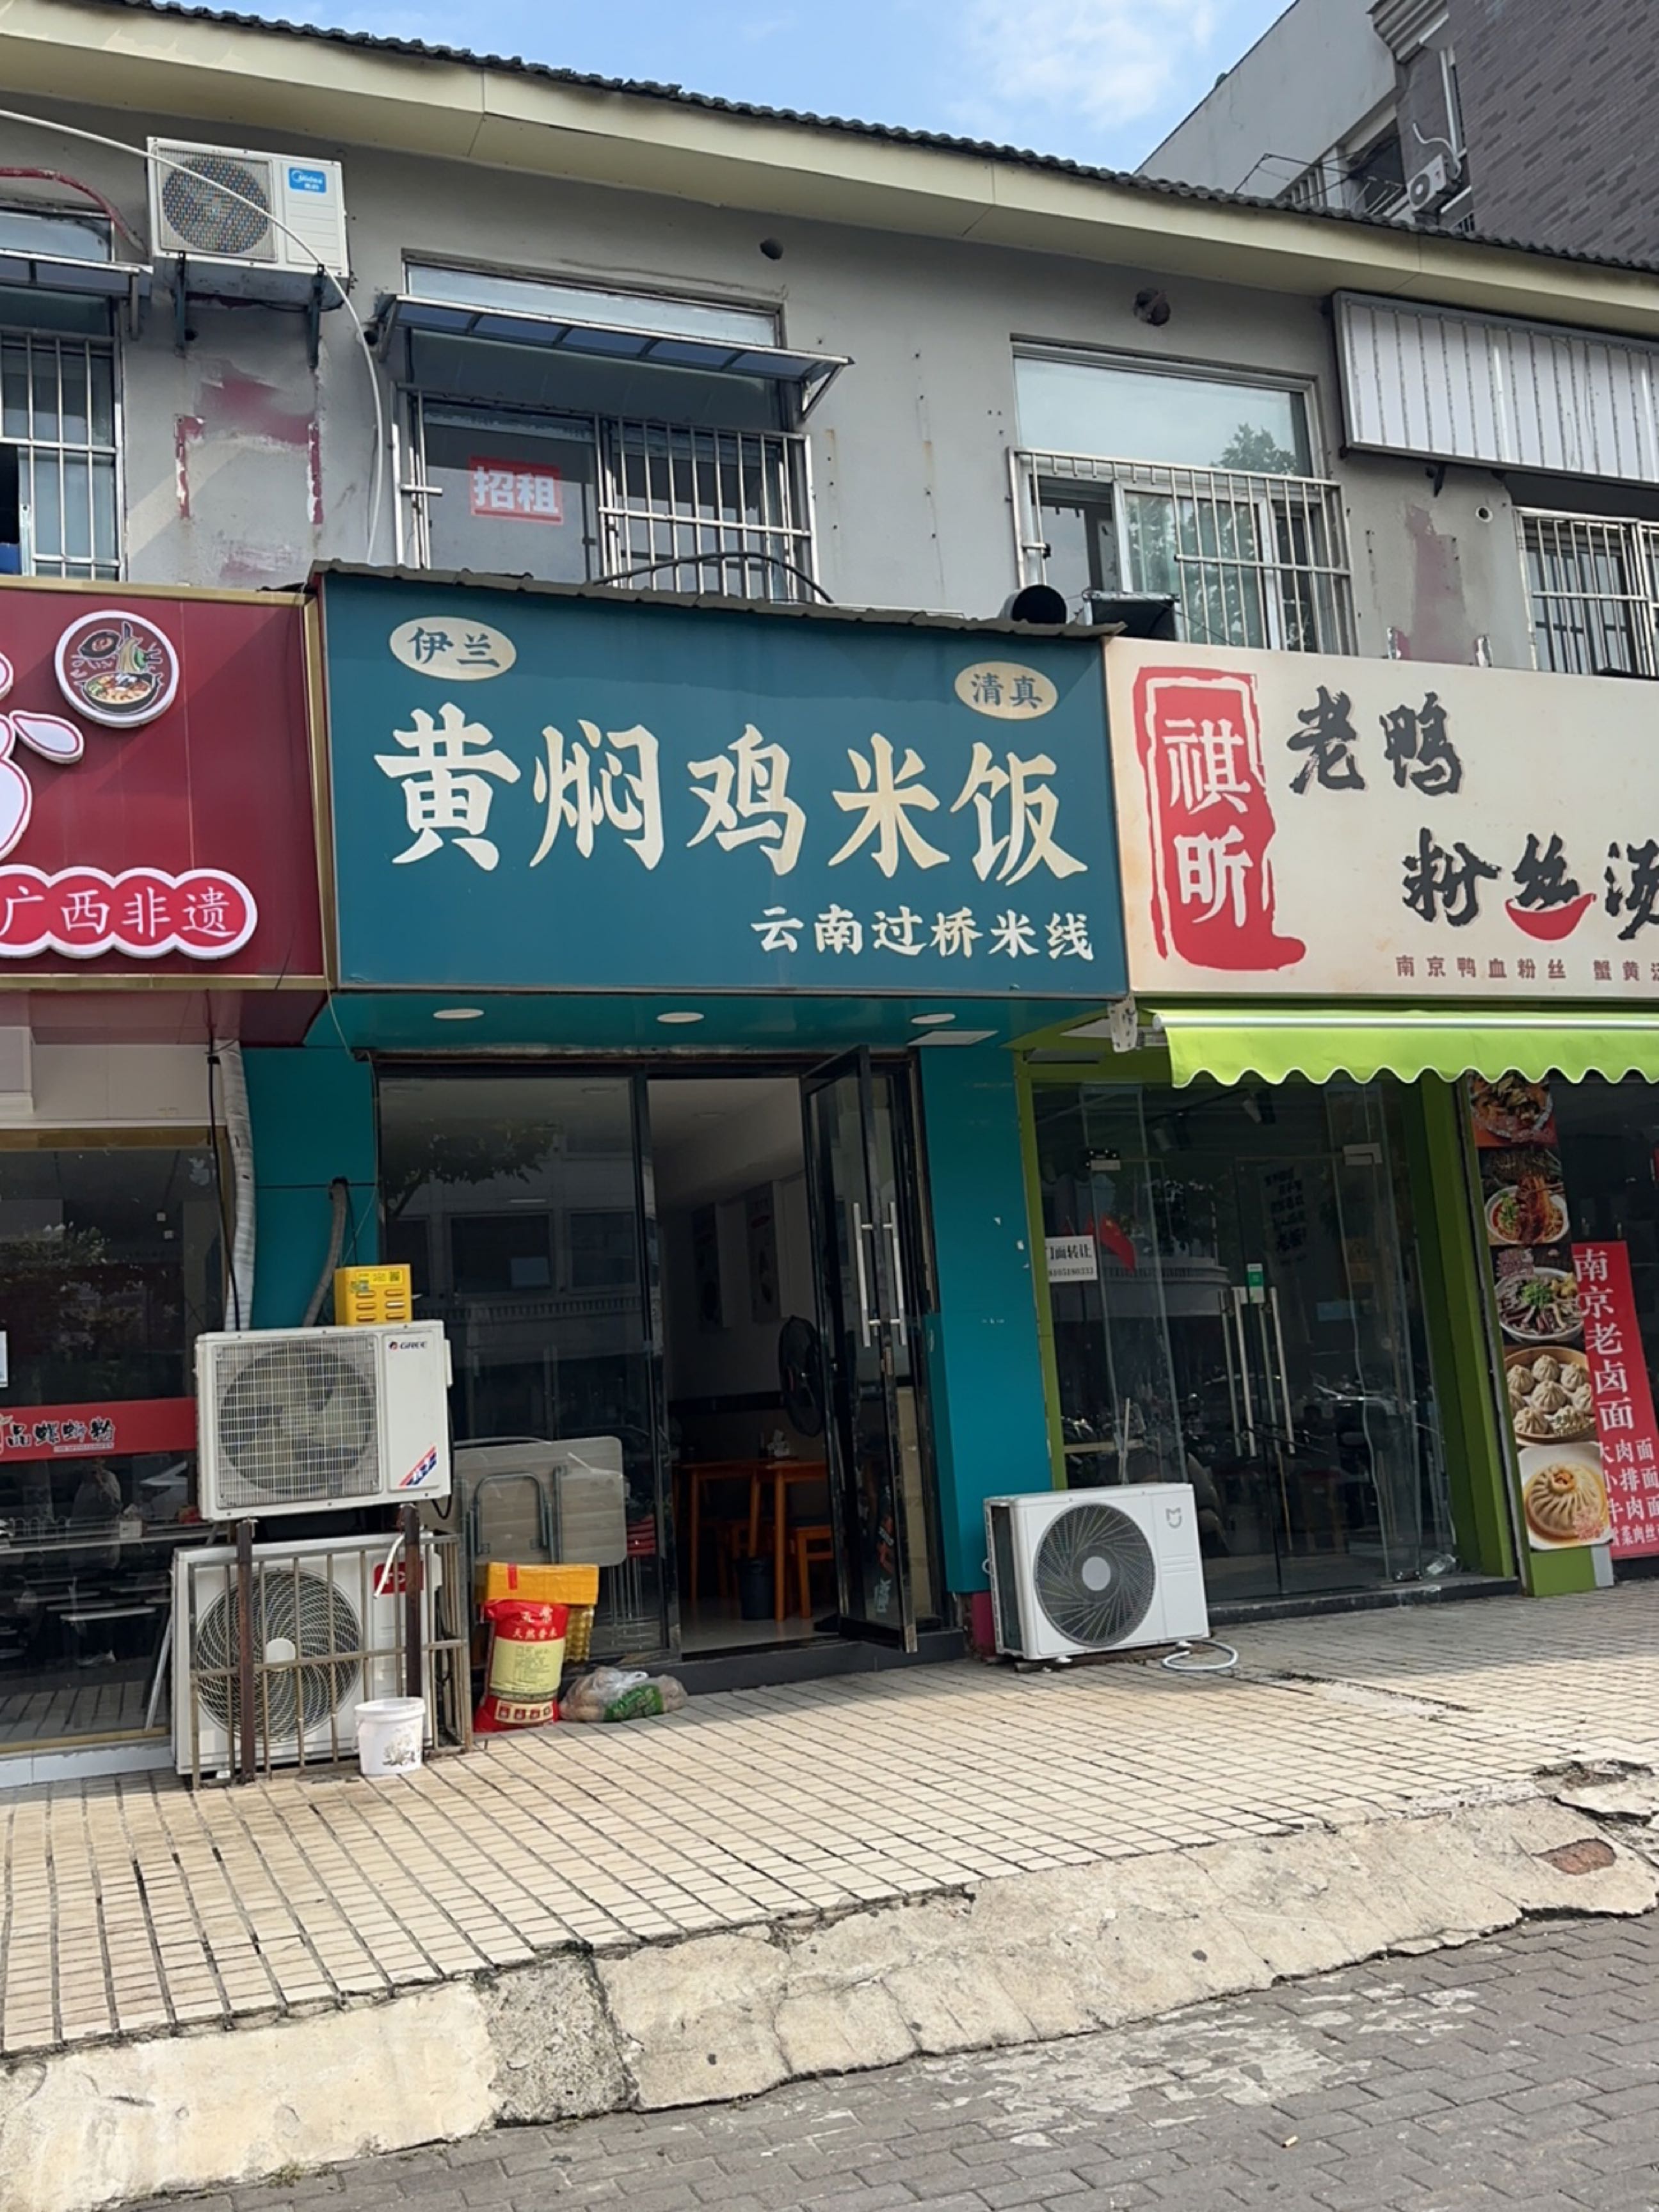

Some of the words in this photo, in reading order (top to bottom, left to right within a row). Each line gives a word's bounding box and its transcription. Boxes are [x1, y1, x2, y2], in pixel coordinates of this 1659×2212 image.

[474, 466, 559, 513] 招租
[408, 627, 501, 668] 伊兰
[970, 672, 1043, 709] 清真
[1286, 685, 1463, 797] 老鸭
[374, 701, 1088, 886] 黄焖鸡米饭
[1162, 717, 1254, 927] 祺昕
[0, 886, 237, 938] 广西非遗
[750, 903, 1094, 961] 云南过桥米线
[1395, 955, 1567, 979] 南京鸭血粉丝
[1572, 1248, 1634, 1431] 南京老卤面
